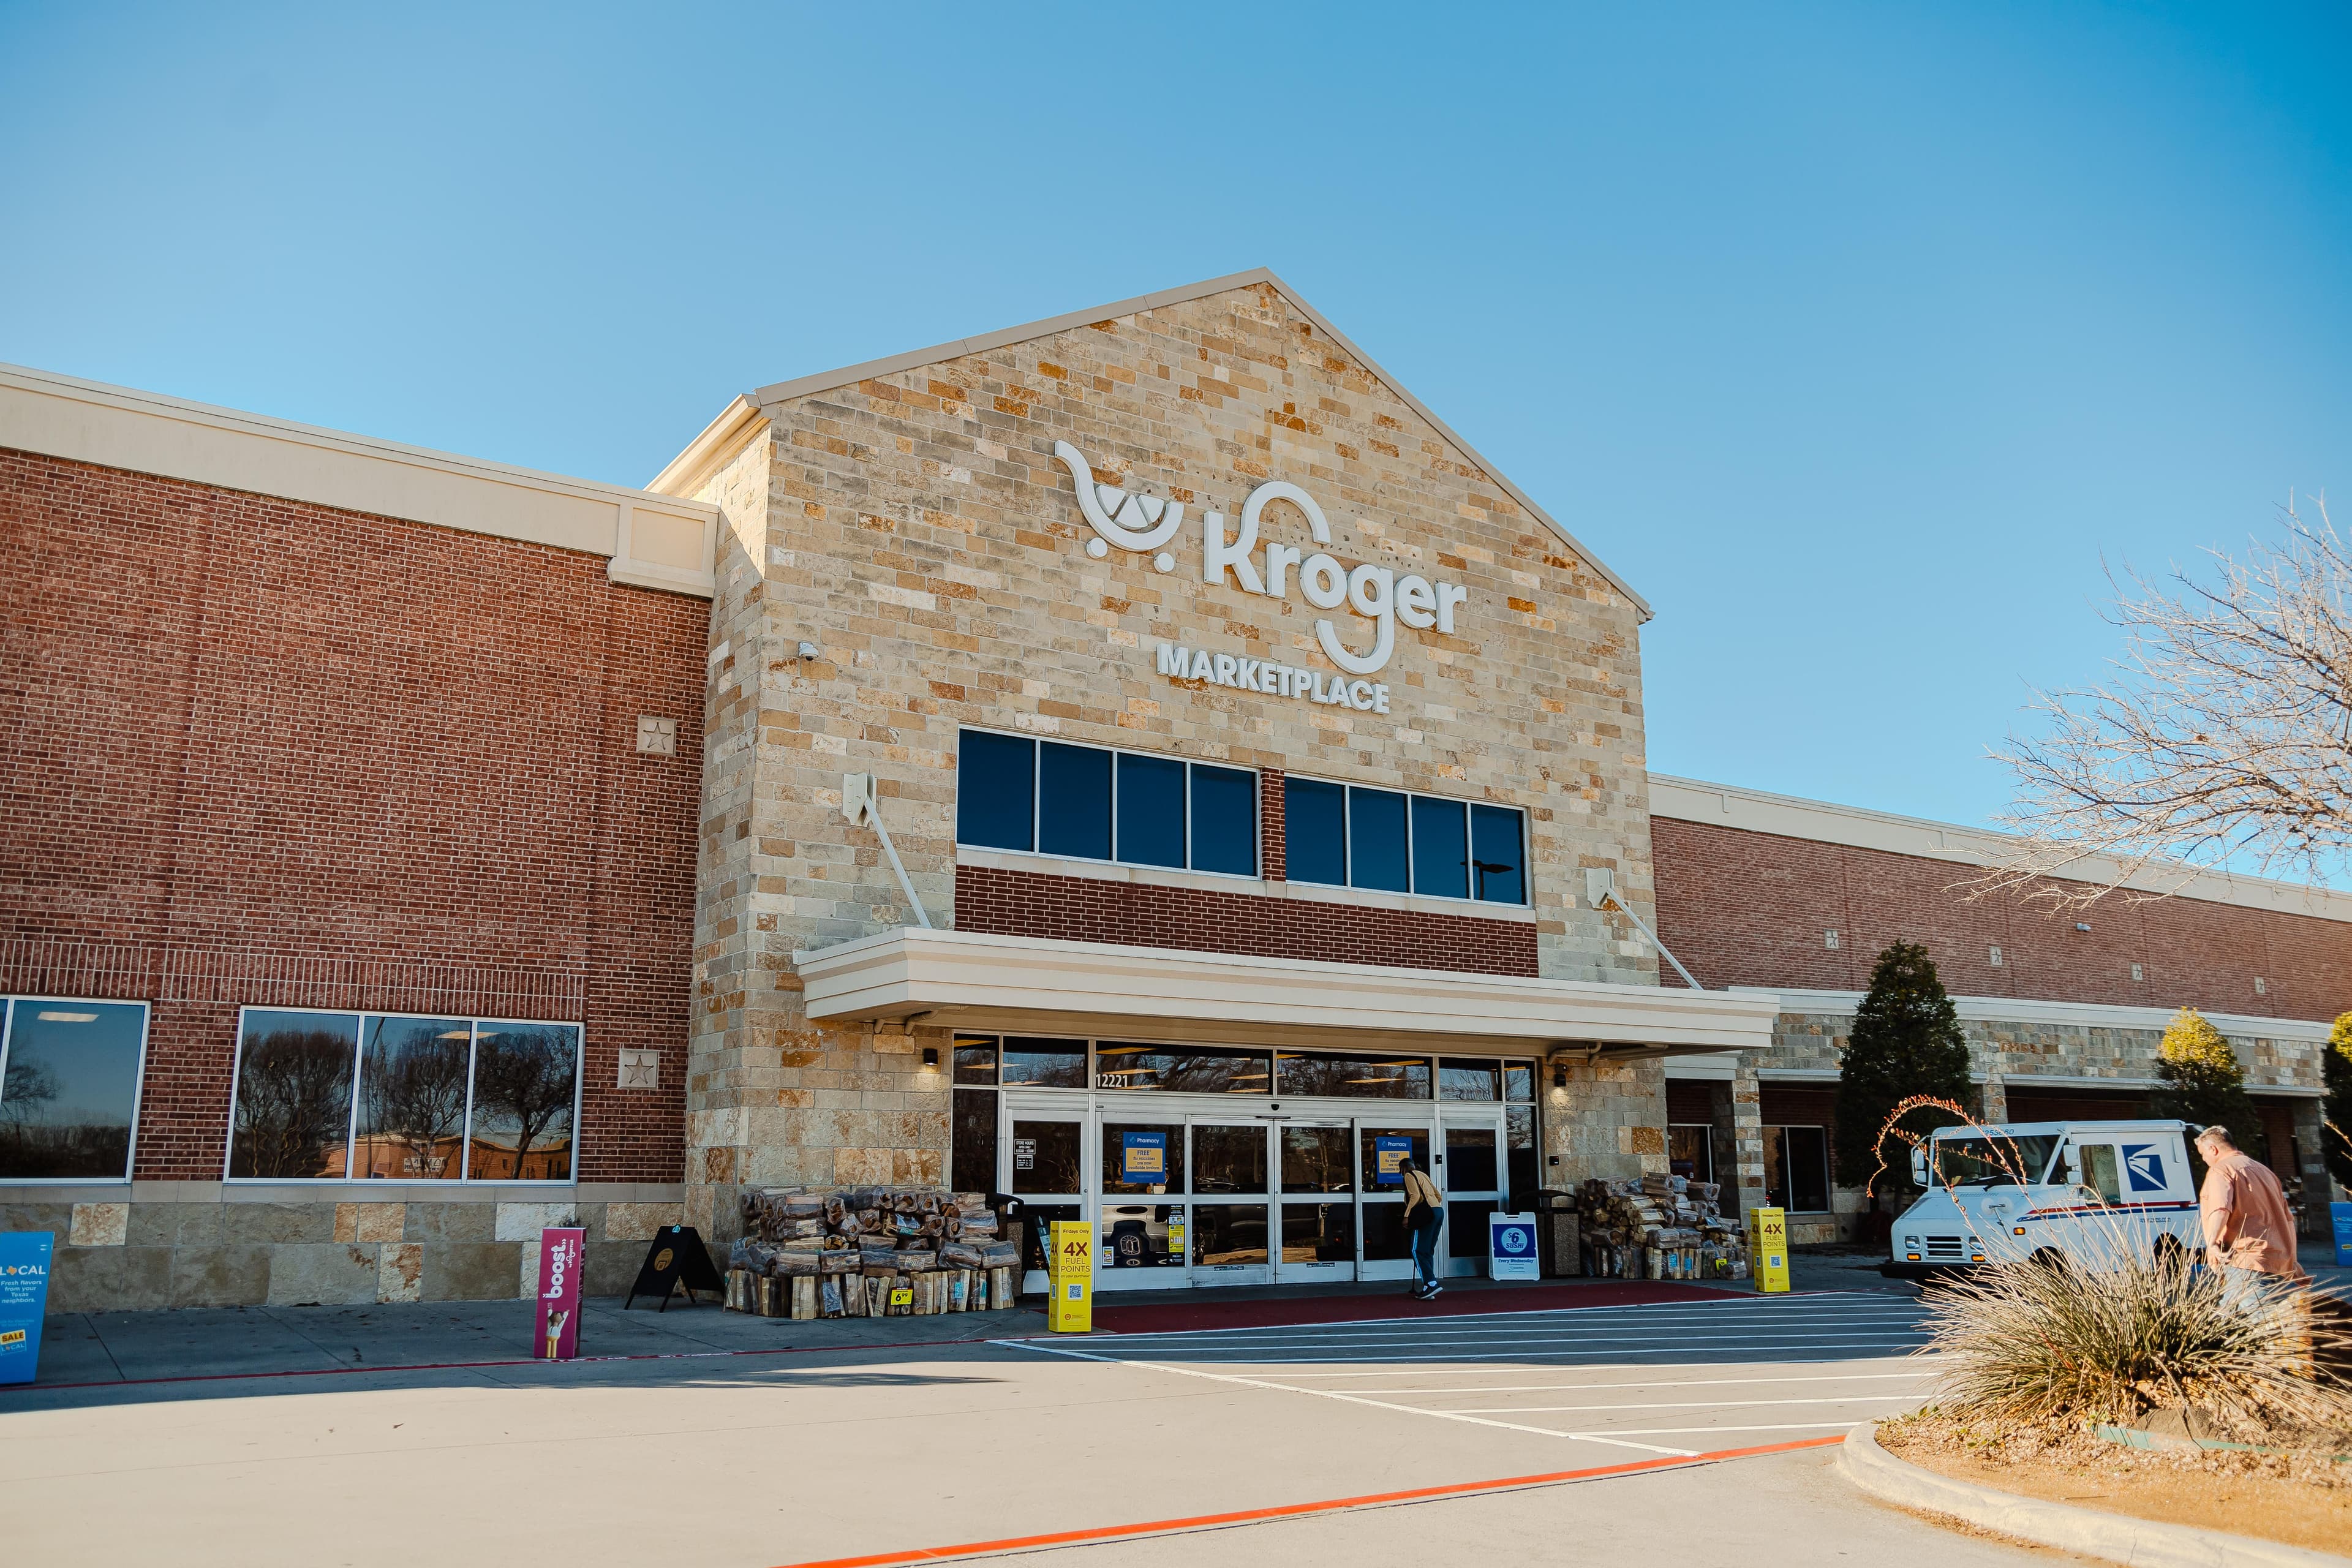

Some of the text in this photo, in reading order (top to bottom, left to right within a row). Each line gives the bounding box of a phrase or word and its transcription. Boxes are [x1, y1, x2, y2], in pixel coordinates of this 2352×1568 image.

[1203, 481, 1466, 674] Kroger
[1157, 643, 1390, 714] MARKETPLACE
[1096, 1074, 1127, 1088] 12221
[1764, 1223, 1782, 1234] 4X
[1507, 1232, 1520, 1243] $6
[1051, 1242, 1058, 1256] 4X
[1063, 1242, 1088, 1257] 4X
[544, 1245, 566, 1298] boost
[2, 1332, 24, 1342] SALE
